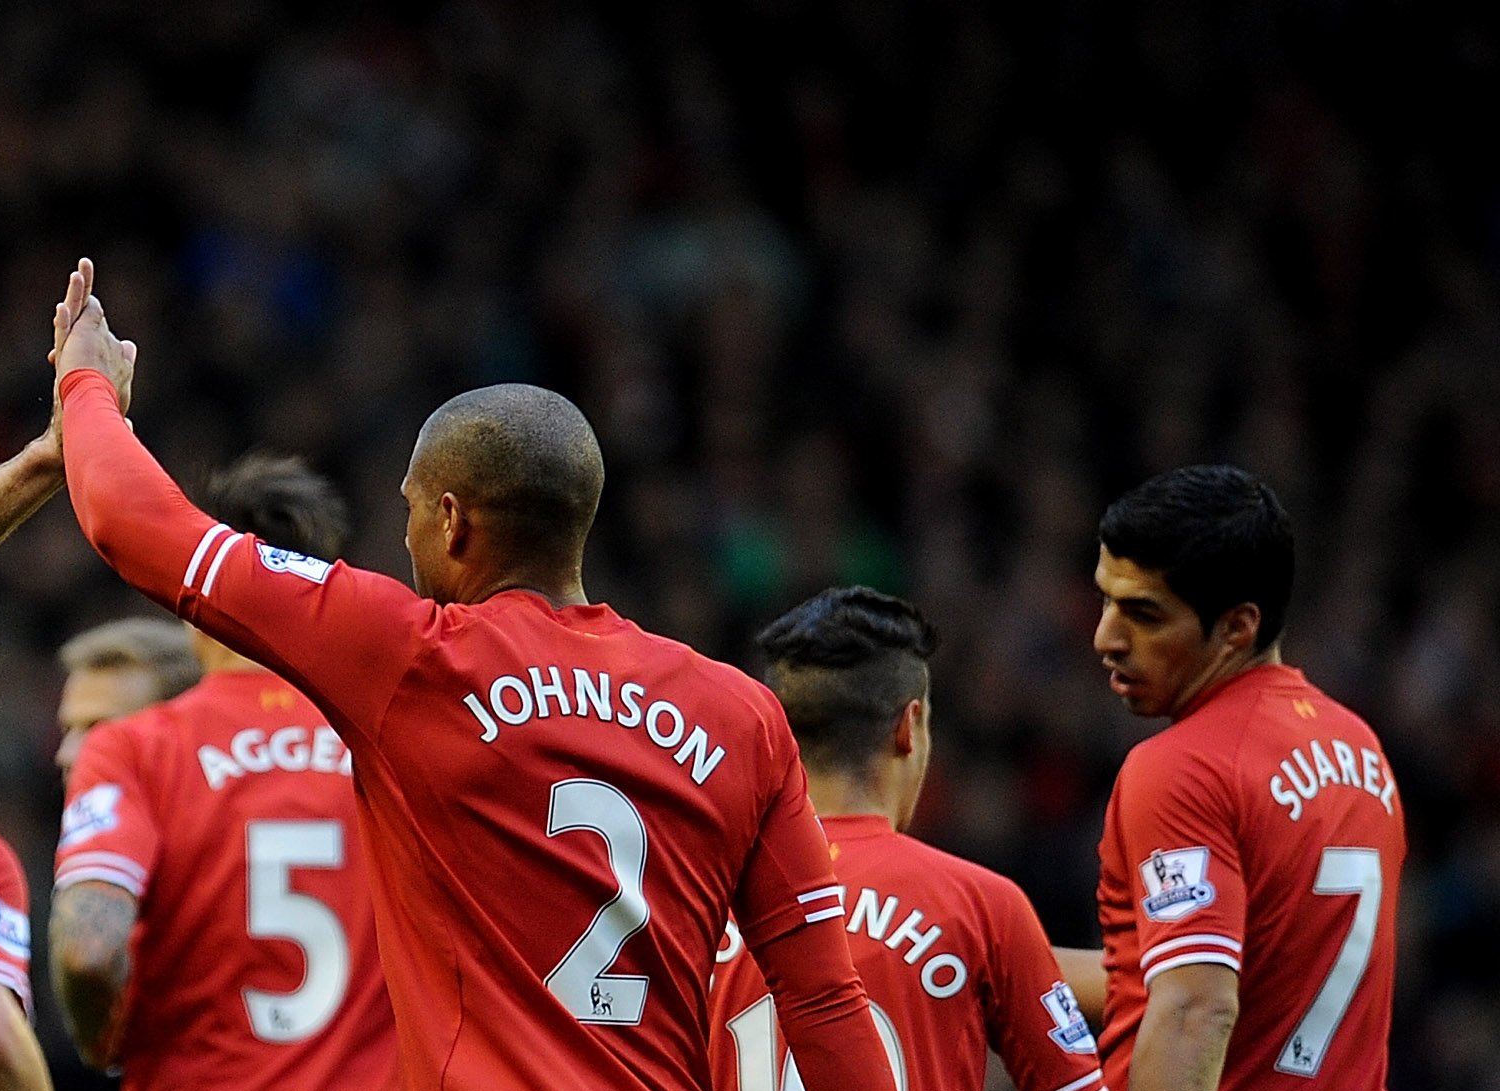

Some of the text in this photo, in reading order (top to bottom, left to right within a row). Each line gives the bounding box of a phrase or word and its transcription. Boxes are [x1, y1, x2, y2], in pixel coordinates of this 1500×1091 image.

[463, 665, 726, 786] JOHNSON
[240, 818, 352, 1045] 5
[543, 777, 650, 1026] 2
[1273, 846, 1383, 1078] 7
